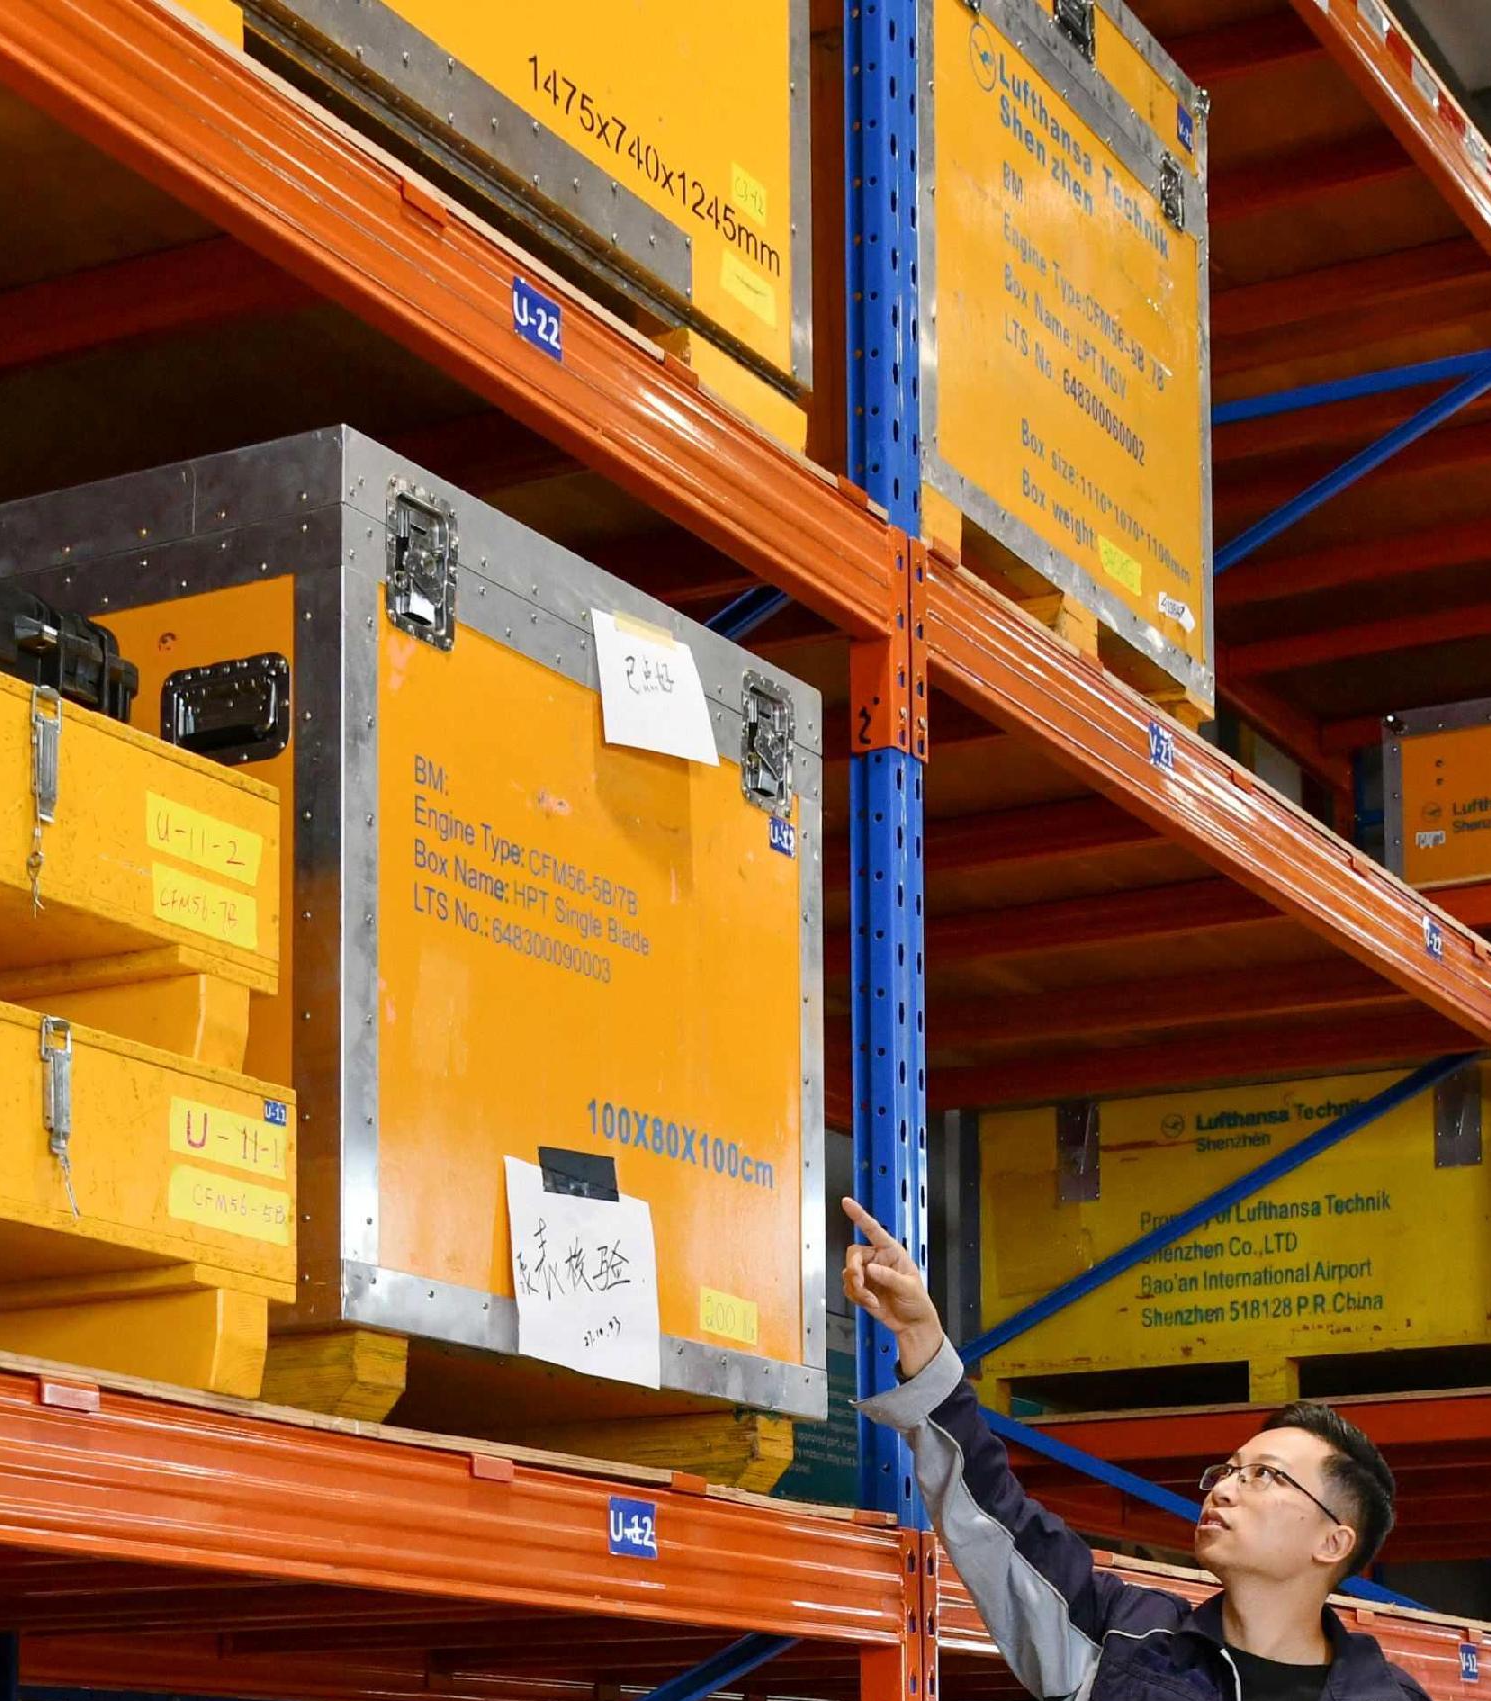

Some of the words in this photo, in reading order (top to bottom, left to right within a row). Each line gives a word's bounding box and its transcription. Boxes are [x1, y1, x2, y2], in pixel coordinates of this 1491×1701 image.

[528, 54, 781, 278] 1475x740x1245mm
[998, 52, 1093, 178] Lufthansa
[1102, 163, 1169, 261] Technik
[1004, 211, 1047, 276] Engine
[1004, 263, 1028, 308] Box
[513, 290, 561, 350] U-22
[1005, 312, 1028, 356] LTS
[1022, 417, 1046, 462] Box
[1022, 467, 1046, 511] Box
[413, 753, 450, 797] BM:
[413, 794, 476, 849] Engine
[480, 822, 526, 868] Type:
[413, 837, 449, 878] Box
[452, 855, 510, 904] Name:
[512, 884, 550, 917] HPT
[554, 895, 603, 939] Single
[608, 917, 650, 958] Blade
[413, 881, 449, 922] LTS
[491, 917, 612, 985] 648300090003
[1195, 1106, 1290, 1132] Lufthansa
[587, 1098, 774, 1189] 100X80X100cm
[1195, 1131, 1271, 1153] Shenzhen
[1236, 1196, 1321, 1225] Lufthansa
[1325, 1190, 1391, 1214] Technik
[1140, 1273, 1198, 1297] Bao'an
[1203, 1261, 1310, 1292] International
[1313, 1257, 1372, 1284] Airport
[1141, 1306, 1225, 1328] Shenzhen
[1229, 1299, 1292, 1322] 518128
[1332, 1291, 1384, 1313] China
